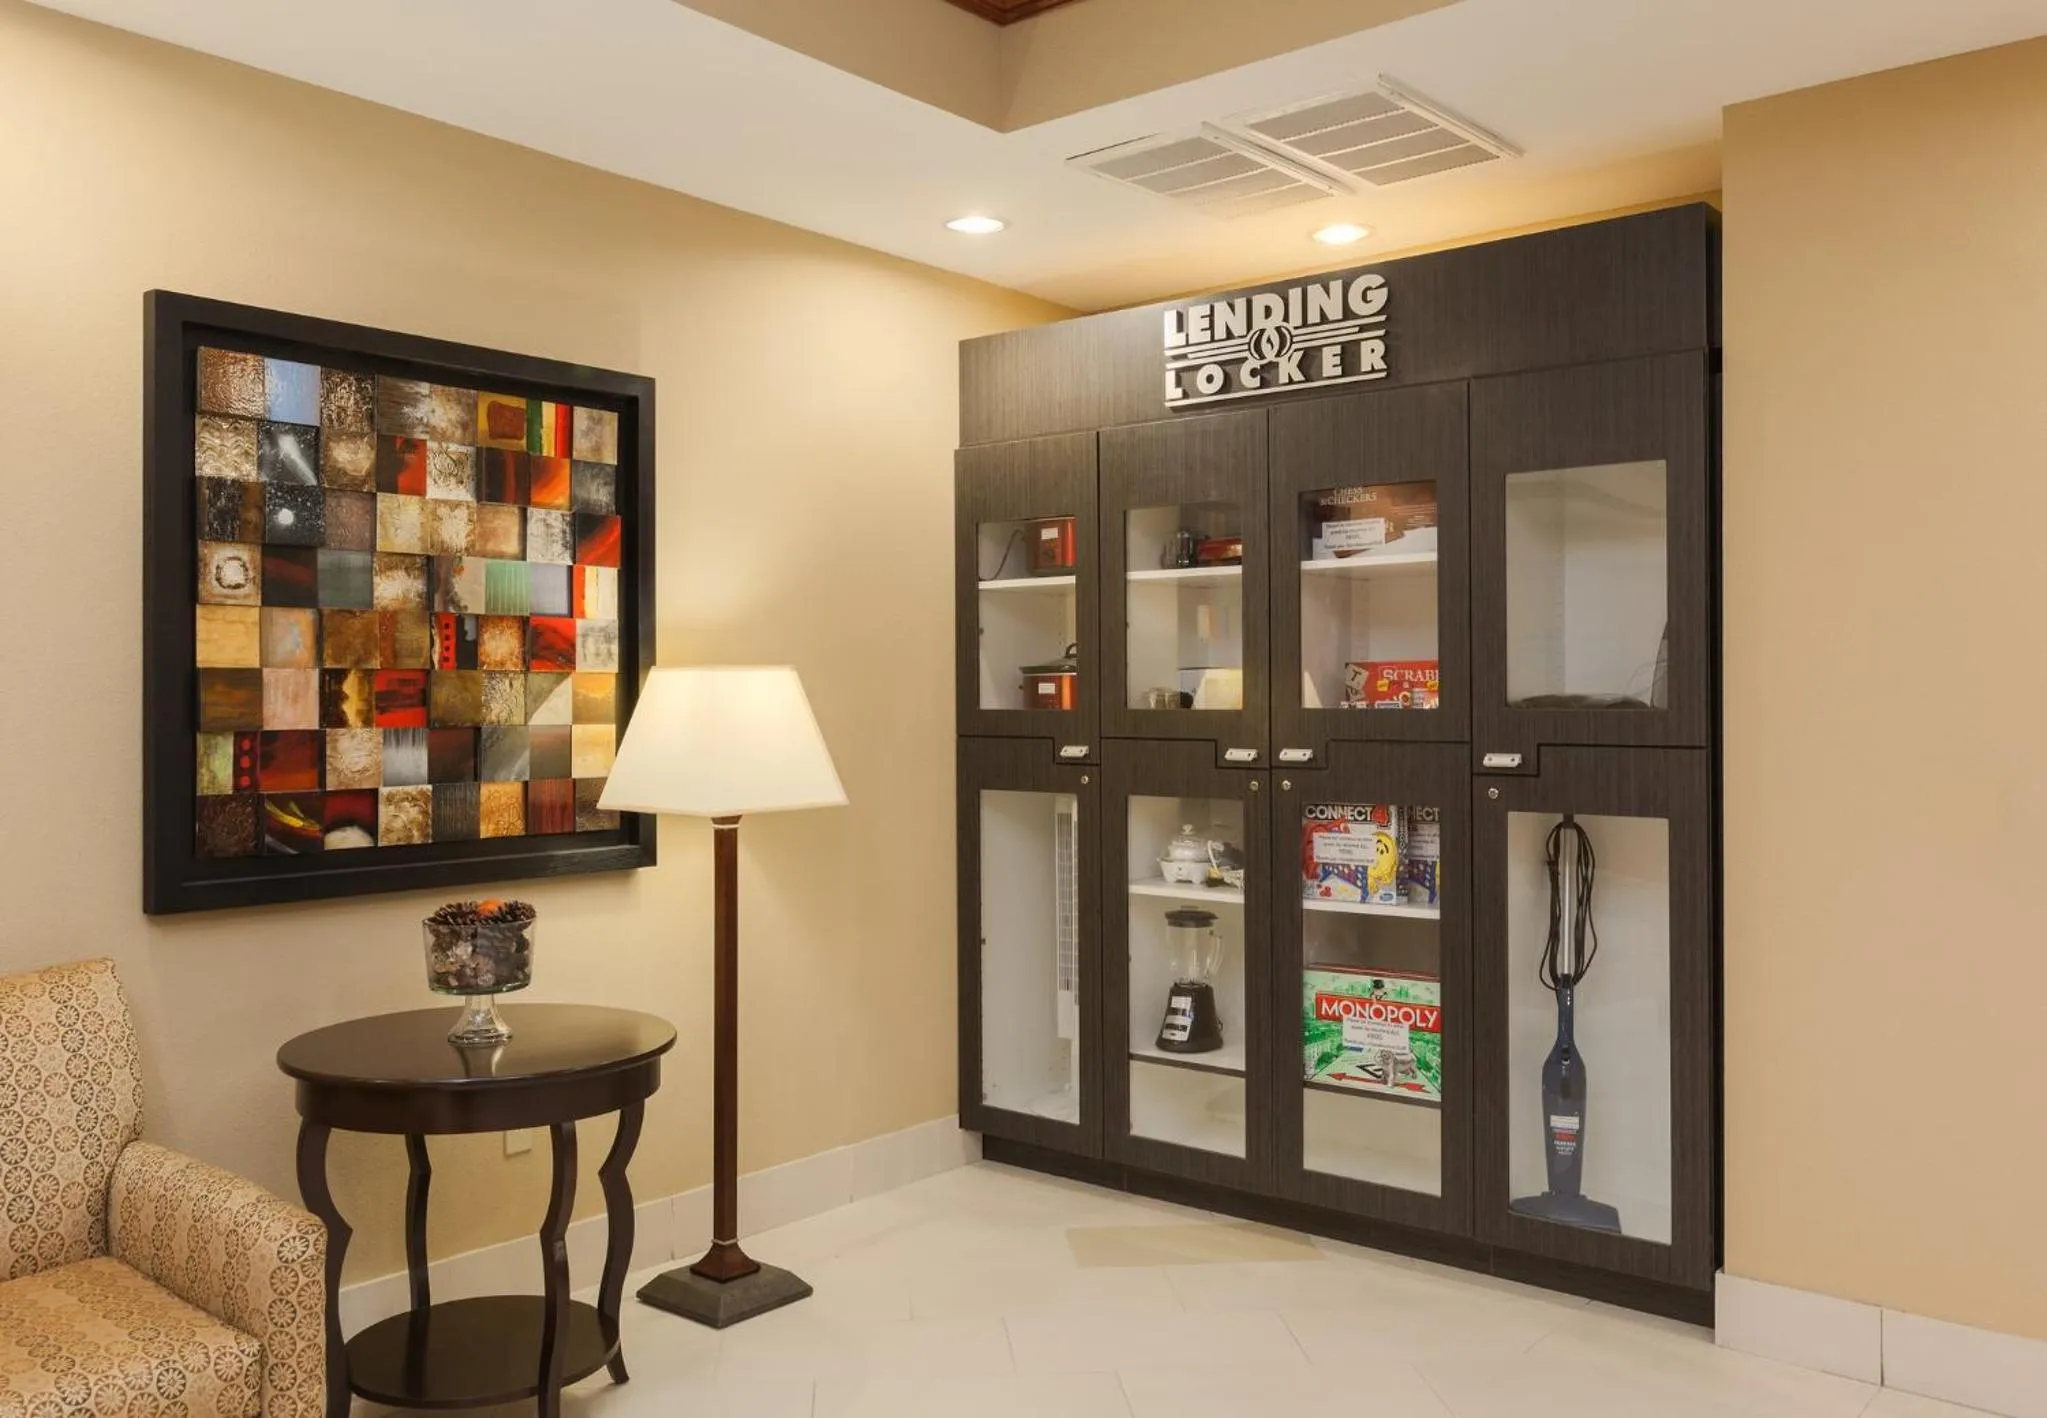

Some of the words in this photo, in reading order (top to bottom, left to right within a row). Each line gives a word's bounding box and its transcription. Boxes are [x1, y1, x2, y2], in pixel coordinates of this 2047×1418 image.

[1163, 273, 1389, 349] LENDING
[1164, 338, 1388, 401] LOCKER
[1304, 805, 1372, 822] CONNECT
[1320, 997, 1438, 1029] MONOPOLY
